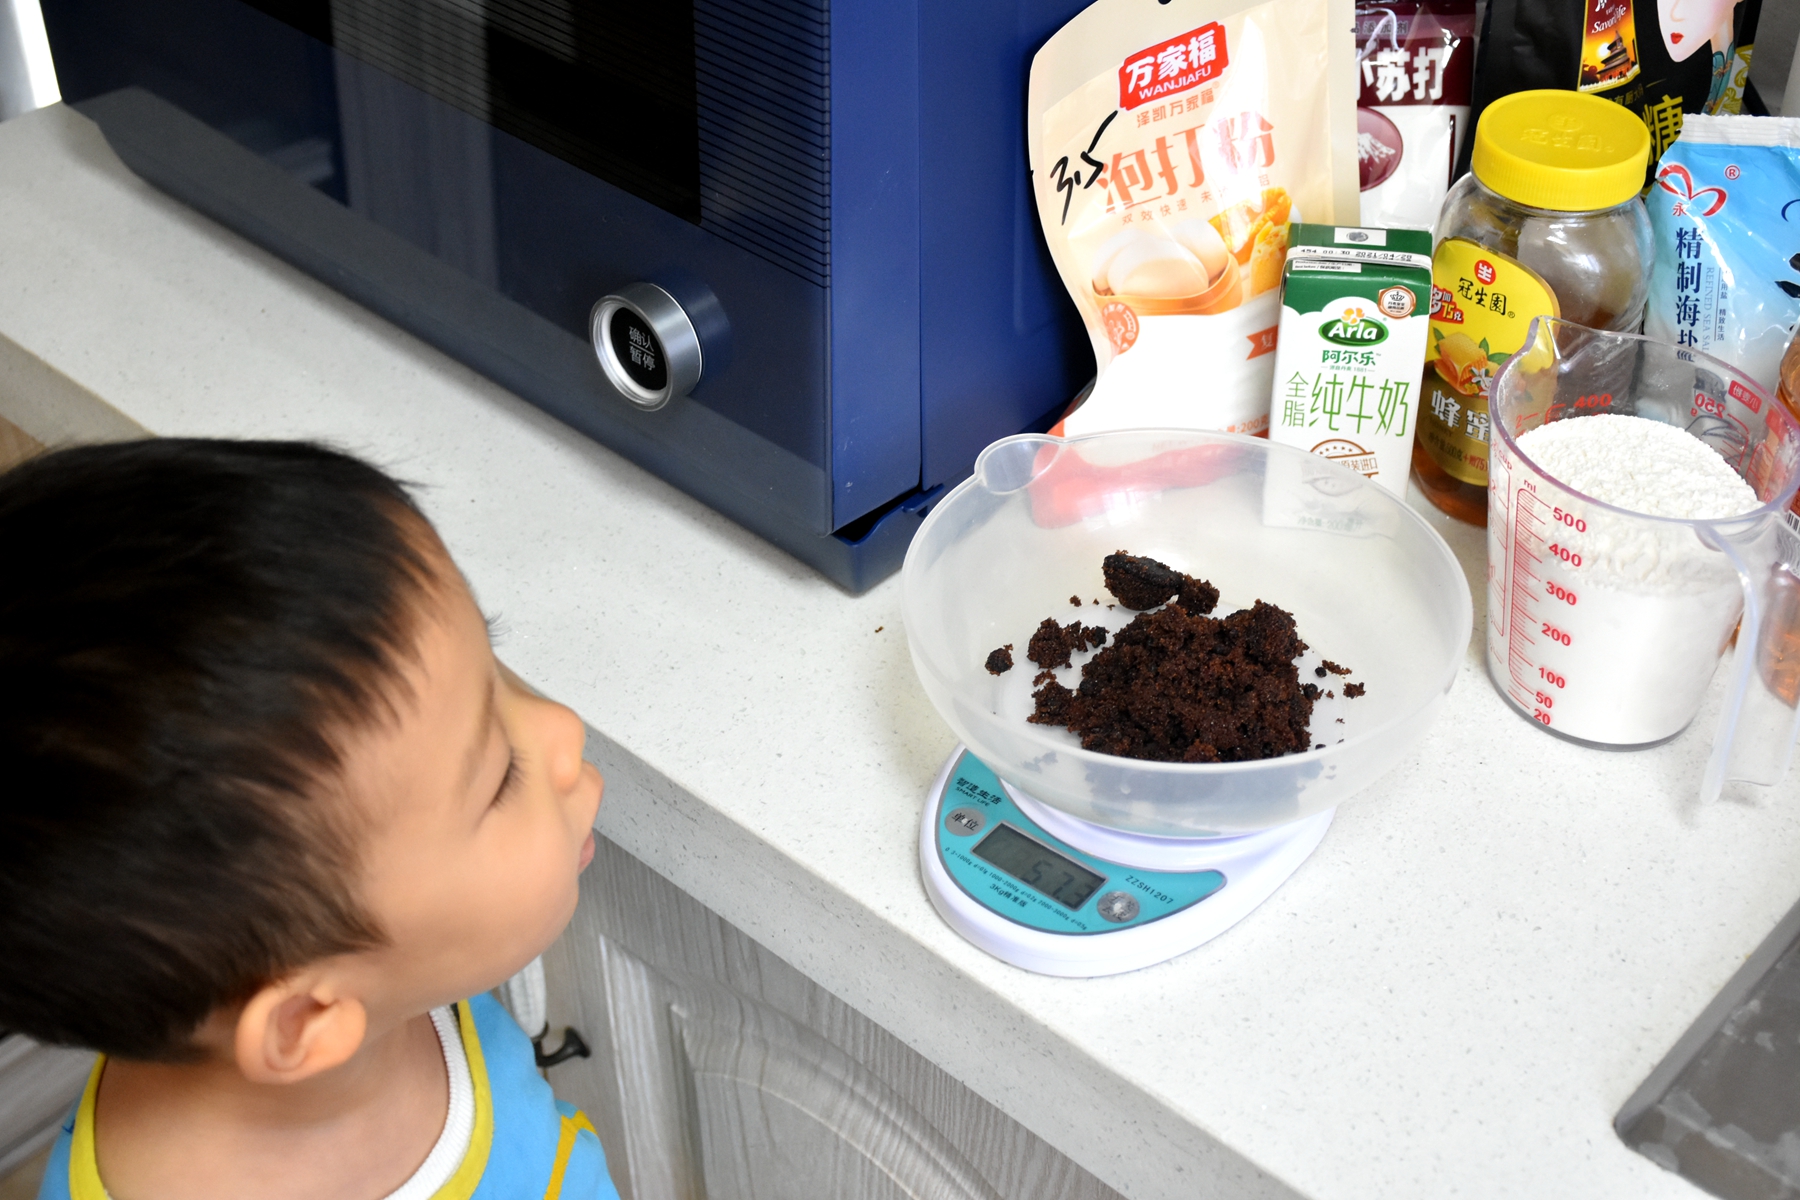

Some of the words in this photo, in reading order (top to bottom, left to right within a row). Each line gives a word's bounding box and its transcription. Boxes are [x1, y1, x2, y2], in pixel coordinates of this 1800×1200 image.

[1125, 29, 1217, 90] 万家福
[1138, 65, 1212, 100] WANJIAFU
[1137, 87, 1215, 128] 泽凯万家福
[1050, 110, 1119, 225] 3.5
[1096, 110, 1276, 215] 泡打粉
[1703, 266, 1716, 311] REFINED
[1328, 321, 1378, 341] Arla
[1702, 313, 1712, 332] SEA
[628, 325, 655, 352] 确认
[629, 345, 656, 371] 暂停
[1321, 350, 1376, 366] 阿尔乐
[1281, 371, 1309, 427] 全脂
[1309, 373, 1410, 437] 纯牛奶
[1573, 393, 1613, 408] 400
[1523, 479, 1537, 493] ml
[1552, 506, 1587, 533] 500
[1548, 543, 1582, 568] 400
[1545, 581, 1577, 607] 300
[1541, 622, 1571, 647] 200
[1538, 667, 1566, 689] 100
[1534, 691, 1553, 709] 50
[1533, 708, 1551, 726] 20
[955, 786, 977, 800] SMART
[977, 798, 990, 807] LIFE
[951, 812, 979, 831] 单位
[1125, 874, 1174, 904] ZZSH1207
